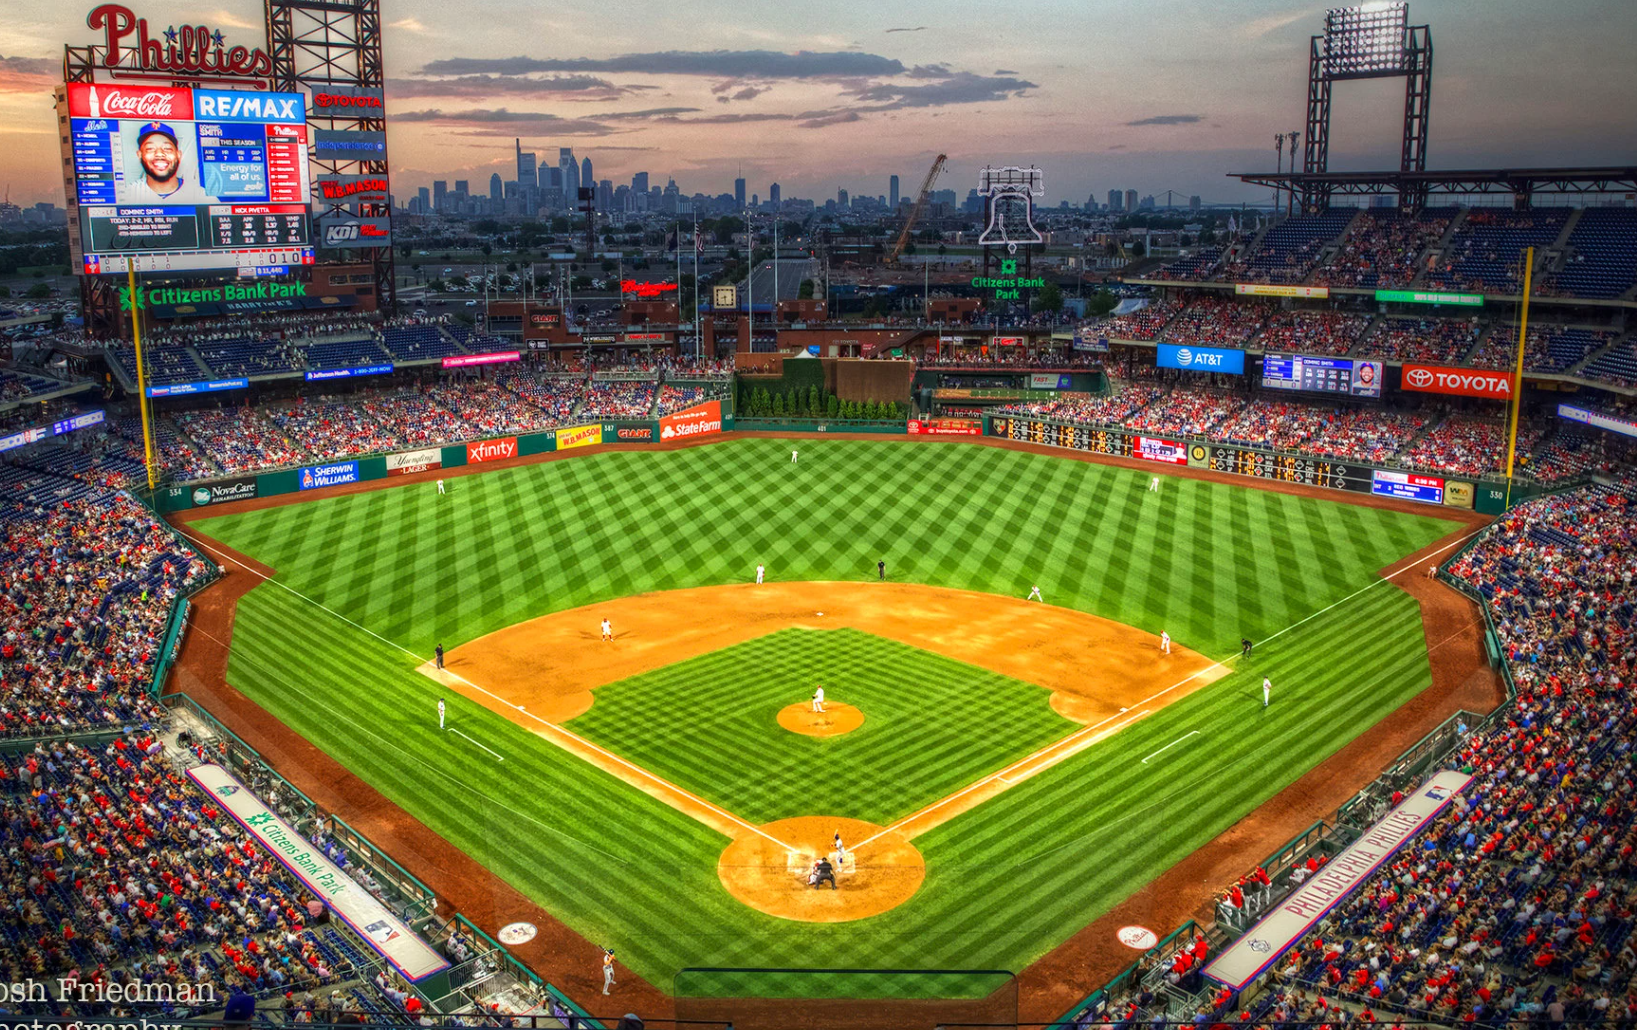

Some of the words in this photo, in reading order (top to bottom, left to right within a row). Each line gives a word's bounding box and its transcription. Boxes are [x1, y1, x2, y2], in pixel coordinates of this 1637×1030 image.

[86, 4, 273, 77] Phillies
[103, 91, 175, 116] Coca-Cola
[199, 95, 296, 119] RE/MAX
[332, 95, 382, 108] TOYOTA
[199, 128, 222, 136] SMITH
[220, 164, 246, 174] Energy
[269, 254, 276, 264] 0
[282, 254, 287, 263] 1
[292, 253, 299, 262] 0
[971, 277, 1015, 288] Citizens
[1017, 276, 1046, 288] Bank
[150, 286, 221, 305] Citizens
[224, 282, 268, 300] Bank
[270, 280, 306, 298] Park
[996, 289, 1020, 299] Park
[530, 314, 558, 323] GIANT
[1194, 353, 1223, 366] AT&T
[1436, 373, 1510, 393] TOYOTA
[618, 429, 651, 438] GIANT
[675, 422, 698, 436] State
[699, 421, 720, 432] Farm
[470, 441, 515, 462] xfinity
[394, 452, 435, 467] Yuengling
[314, 464, 353, 477] SHERWIN
[403, 465, 427, 474] LAGER
[169, 488, 182, 496] 334
[212, 483, 256, 497] NovaCare
[1489, 490, 1503, 499] 330
[1366, 810, 1422, 850] PHILLIES
[262, 824, 300, 856] Citizens
[294, 852, 324, 876] Bank
[317, 871, 346, 896] Park
[1284, 849, 1380, 919] PHILADELPHIA
